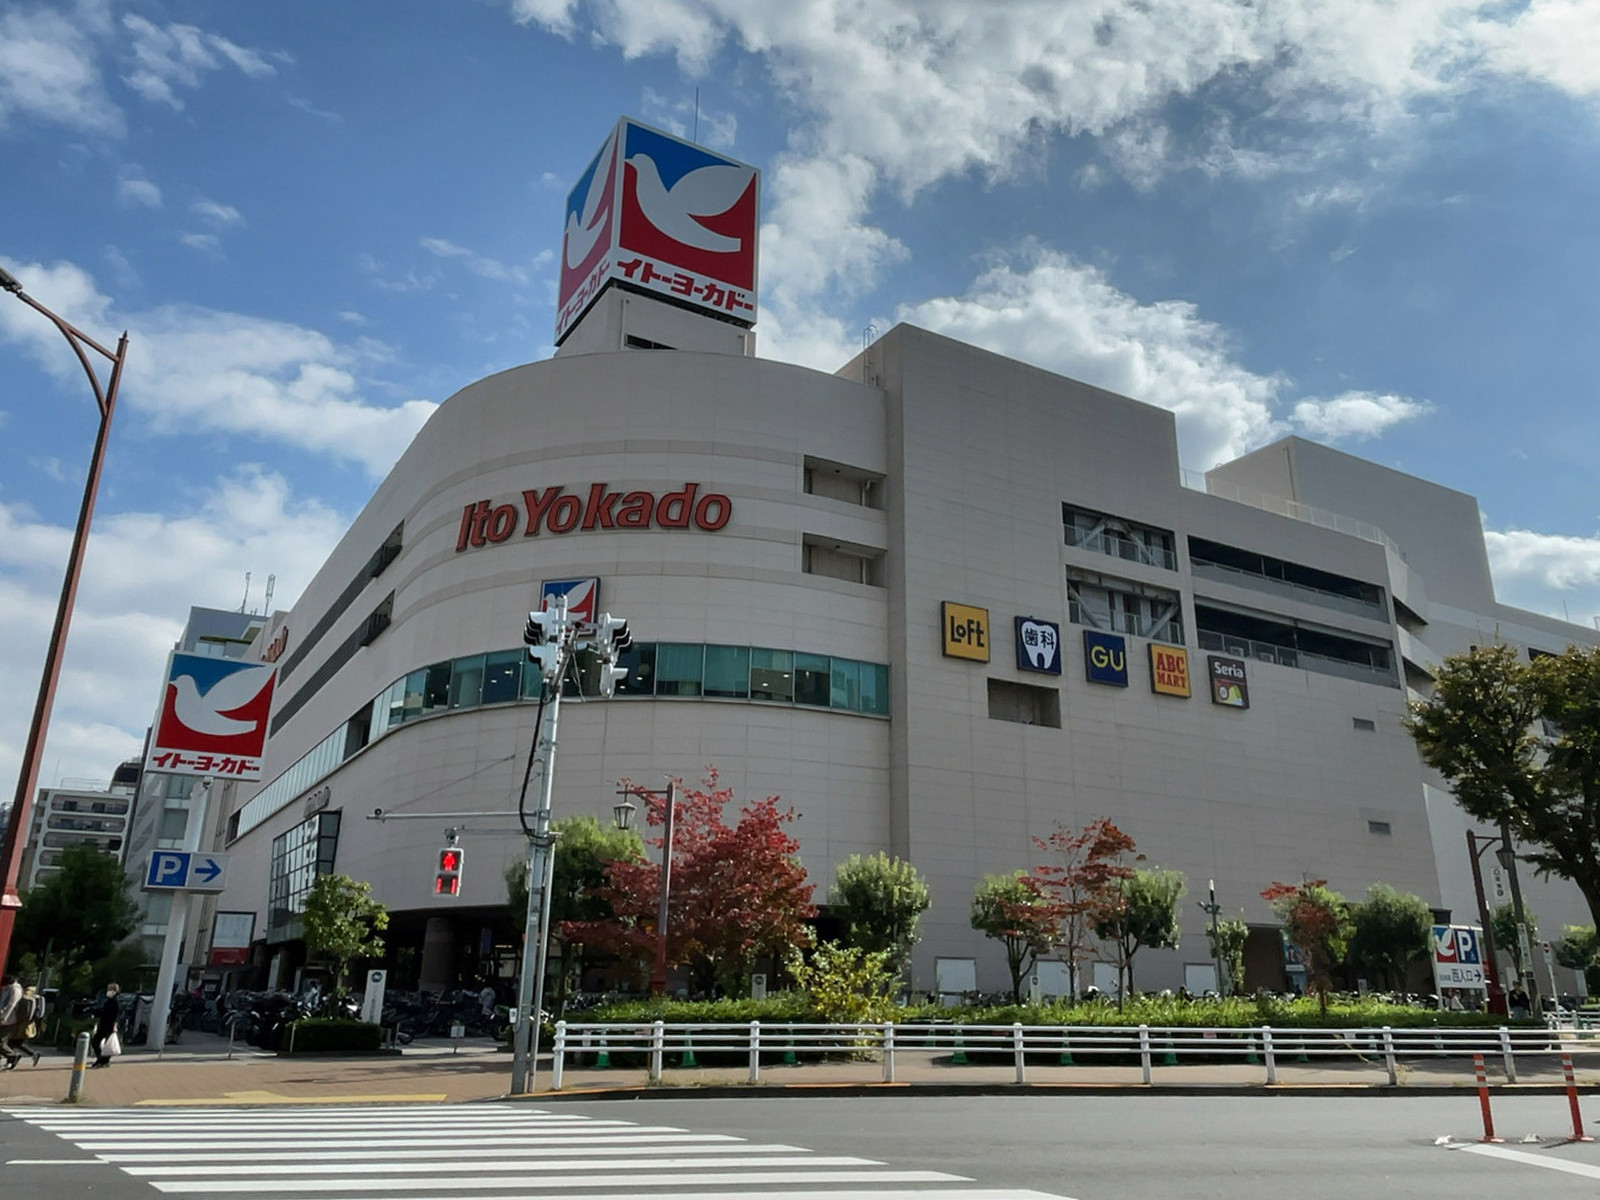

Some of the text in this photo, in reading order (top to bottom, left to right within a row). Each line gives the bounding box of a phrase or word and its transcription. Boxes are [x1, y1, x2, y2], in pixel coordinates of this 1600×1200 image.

[617, 258, 754, 311] イトーヨーカドー
[1024, 627, 1055, 650] 歯科
[1091, 645, 1124, 671] GU
[1156, 652, 1185, 675] ABC
[1214, 661, 1244, 678] Seria
[1157, 671, 1187, 689] MART
[152, 752, 260, 775] イトーヨーカドー
[155, 855, 183, 883] P
[1457, 931, 1473, 961] P
